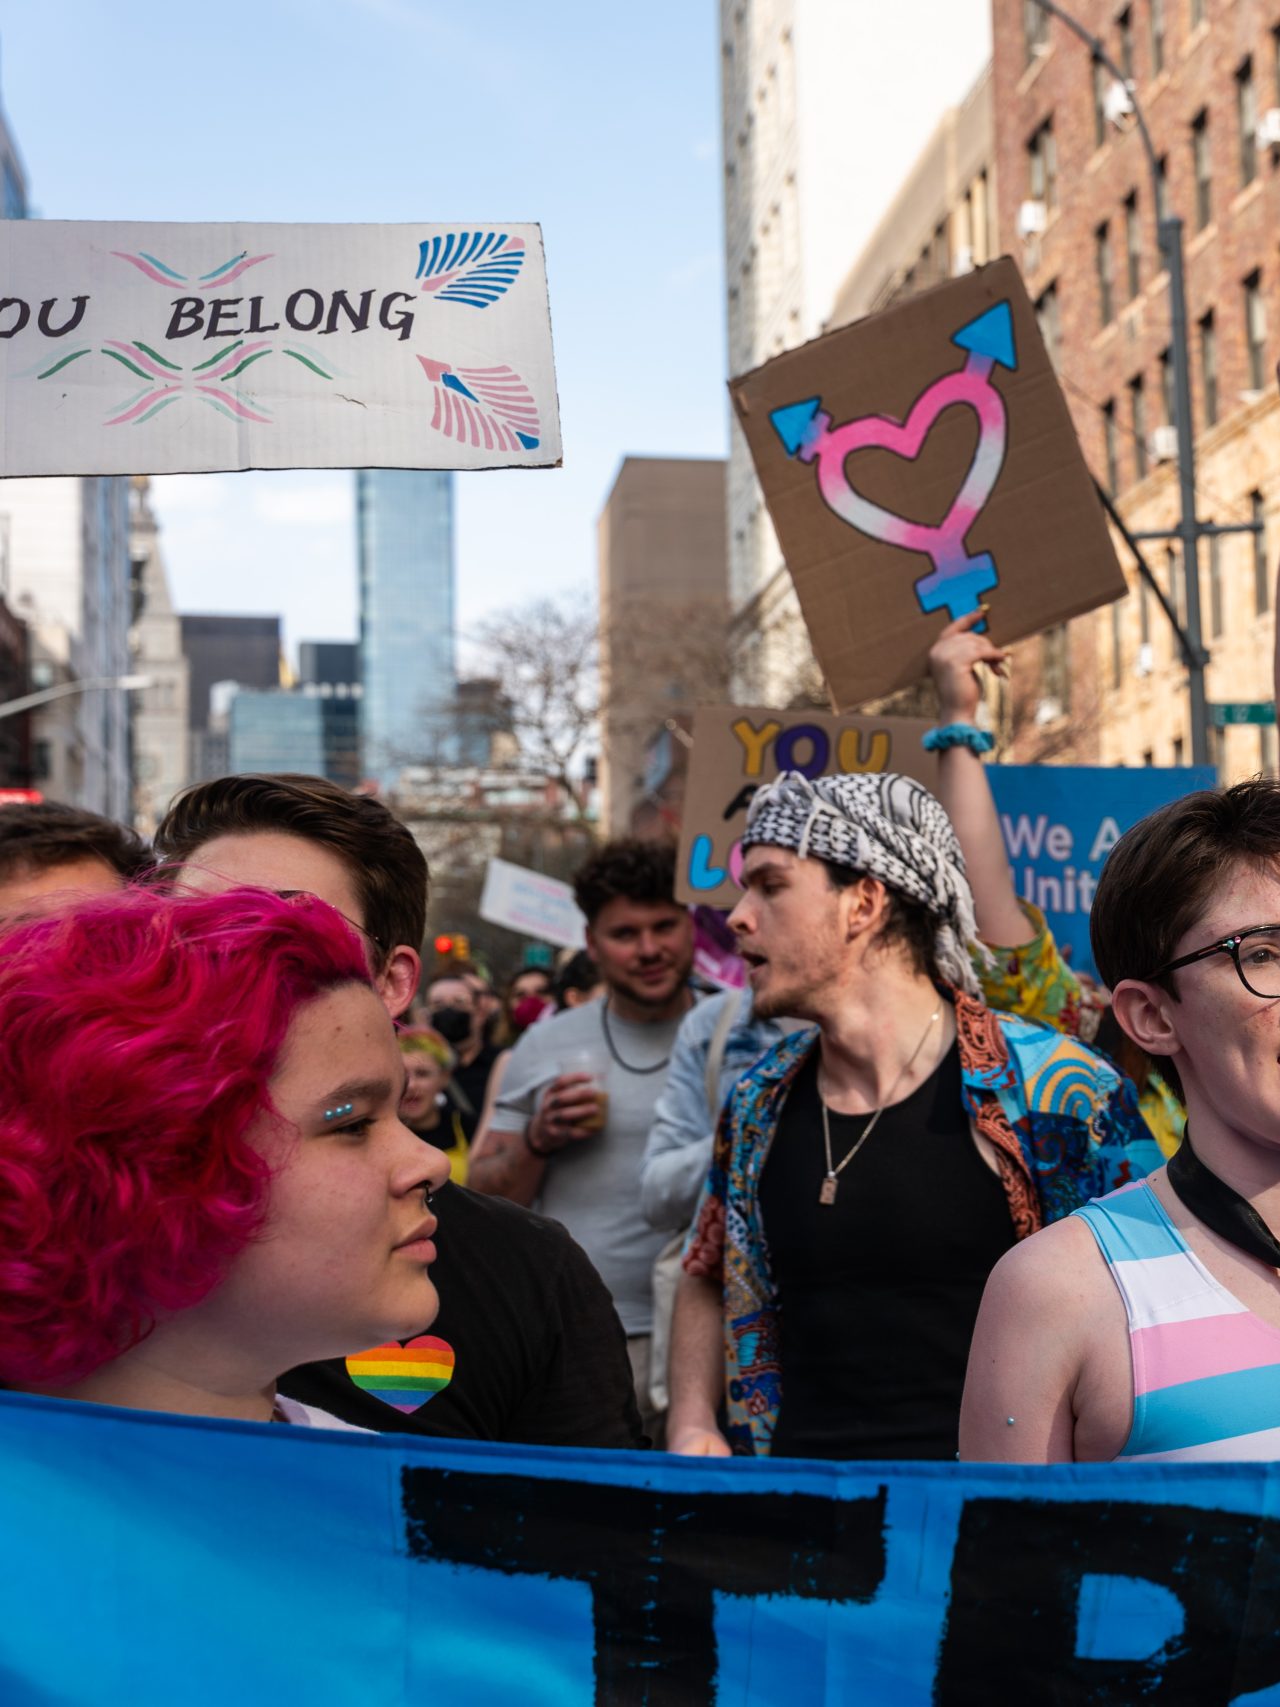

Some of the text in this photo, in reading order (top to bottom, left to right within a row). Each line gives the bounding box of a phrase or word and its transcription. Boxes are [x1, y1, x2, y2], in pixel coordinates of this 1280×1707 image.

[166, 289, 417, 341] BELONG
[732, 718, 890, 782] YOU
[1001, 814, 1073, 861] We
